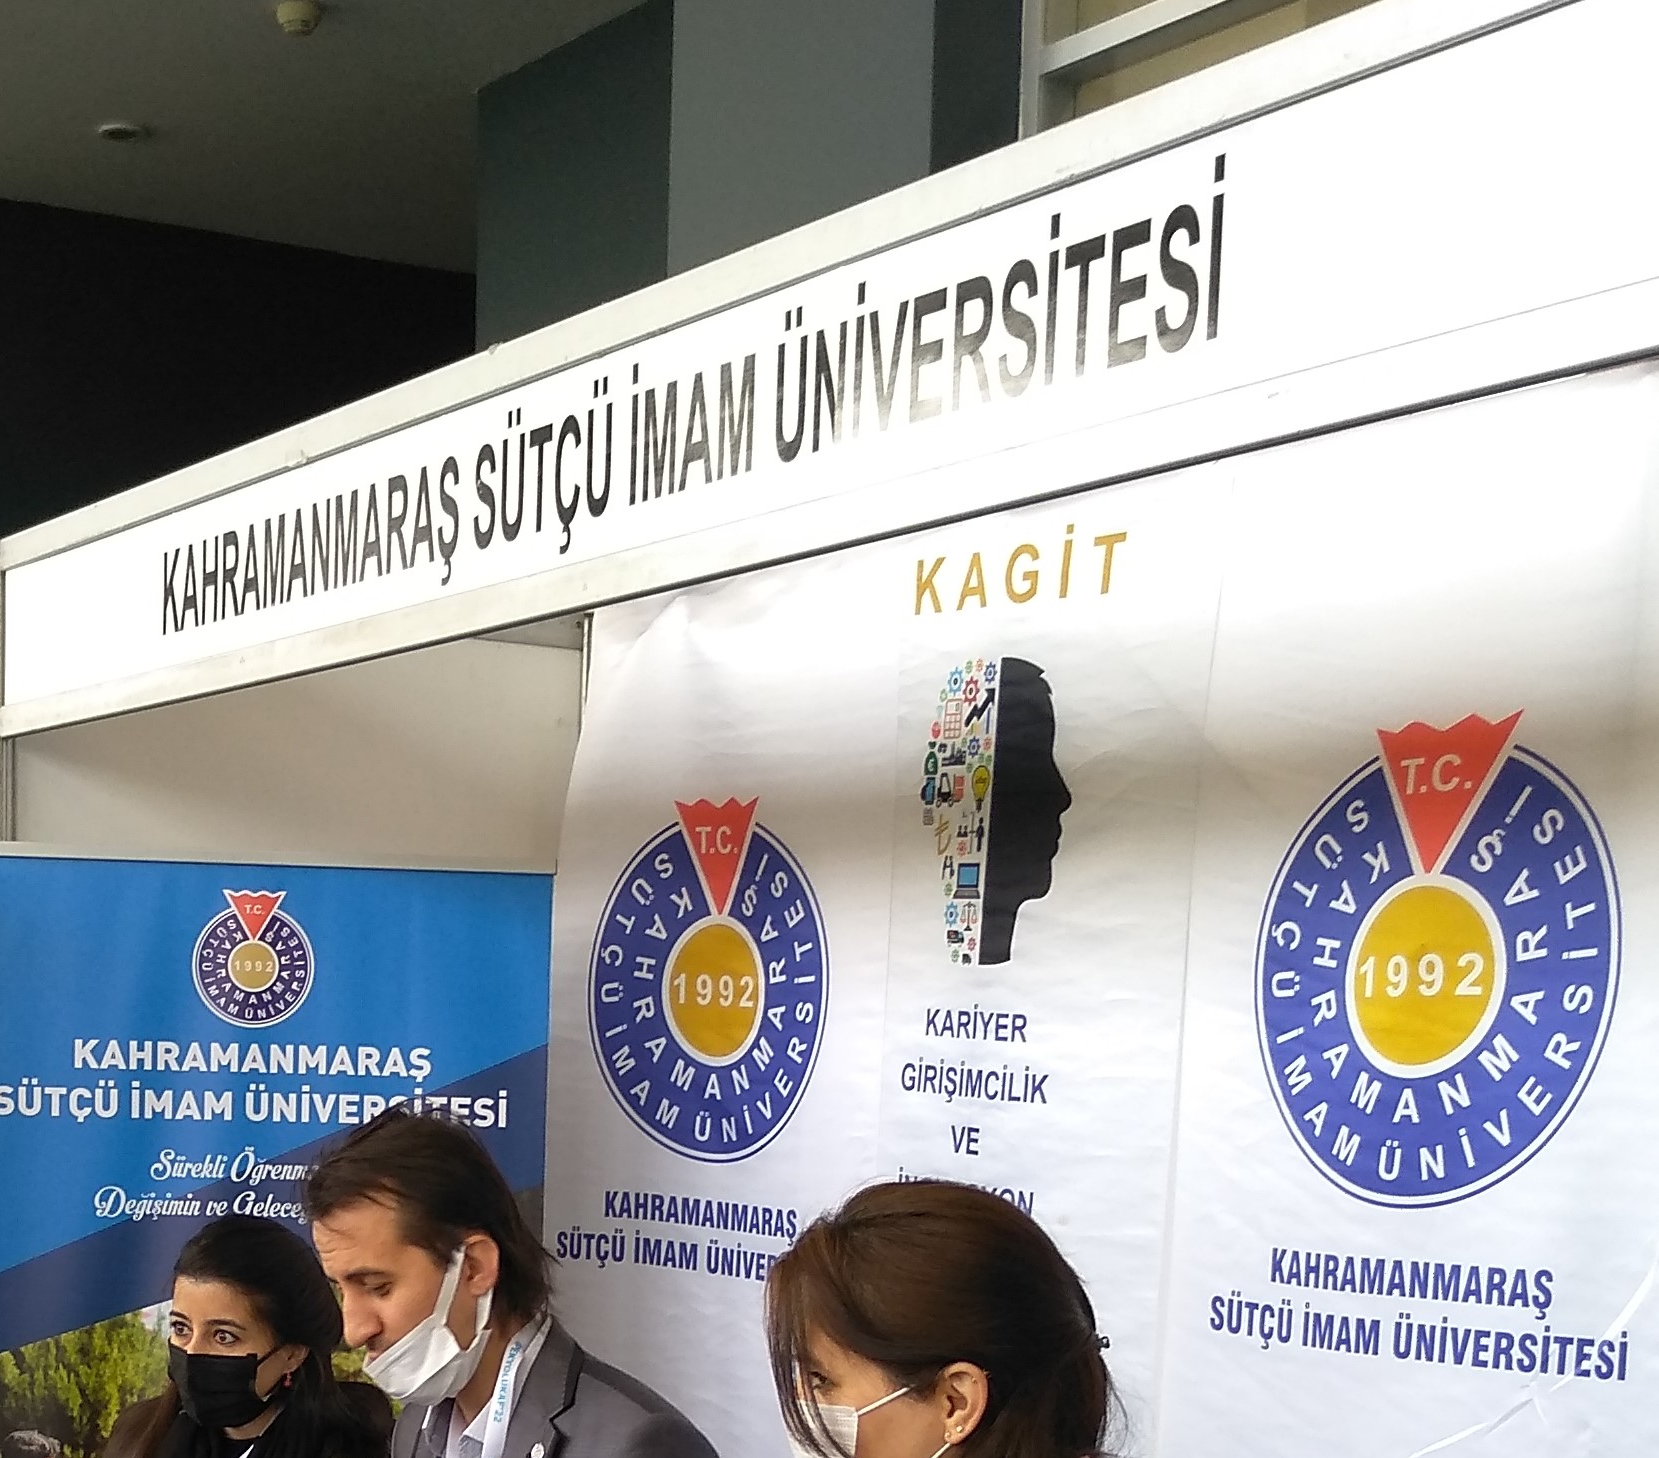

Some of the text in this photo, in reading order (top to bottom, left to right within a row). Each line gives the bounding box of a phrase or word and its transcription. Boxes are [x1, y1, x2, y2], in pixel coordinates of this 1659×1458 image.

[161, 153, 1228, 634] KAHRAMANMARAŞ SÜTÇÜ İMAM ÜNİVERSİTESİ
[915, 523, 1127, 615] KAGİT
[1400, 753, 1473, 795] T.C.
[695, 826, 738, 855] T.C.
[234, 960, 274, 972] 1992
[1358, 953, 1486, 998] 1992
[673, 972, 755, 1008] 1992
[925, 1003, 1028, 1043] KARİYER
[73, 1038, 432, 1082] KAHRAMANMARAŞ
[901, 1056, 1049, 1104] GİRİŞİMCİLİK
[130, 1080, 233, 1121] İMAM
[951, 1125, 980, 1156] VE
[150, 1146, 318, 1186] Sürekli Öğrenm
[94, 1186, 202, 1221] Değişimin
[206, 1200, 228, 1217] ve
[604, 1191, 797, 1247] KAHRAMANMARAŞ
[556, 1226, 626, 1268] SÜTÇÜ
[634, 1229, 698, 1271] İMAM
[1270, 1247, 1553, 1320] KAHRAMANMARAŞ
[1209, 1290, 1628, 1381] SÜTÇÜ İMAM ÜNİVERSİTESİ
